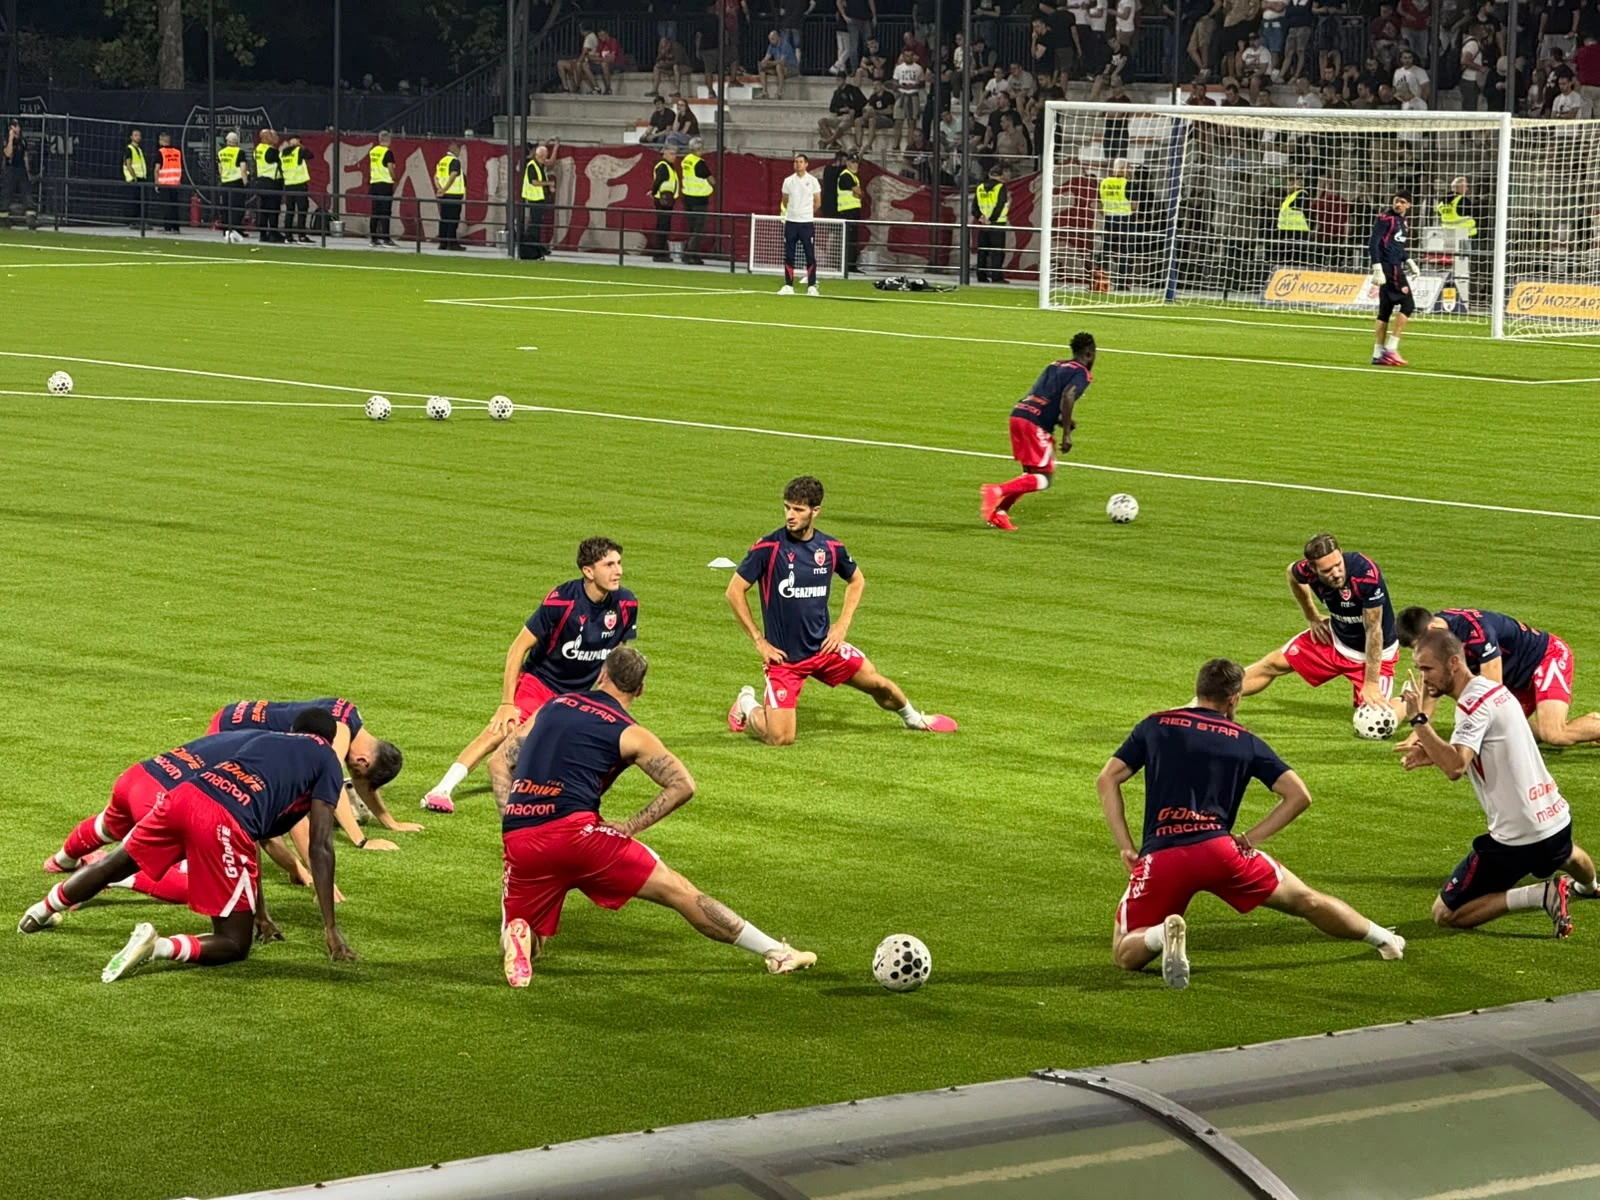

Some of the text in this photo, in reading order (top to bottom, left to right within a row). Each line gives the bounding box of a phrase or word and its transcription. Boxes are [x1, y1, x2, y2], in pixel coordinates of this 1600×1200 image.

[1298, 281, 1358, 297] MOZZART
[795, 585, 828, 599] GAZPROM
[579, 705, 617, 724] STAR
[1159, 717, 1240, 739] RED STAR
[200, 771, 252, 807] macron
[505, 803, 556, 817] macron
[1155, 822, 1222, 838] macron
